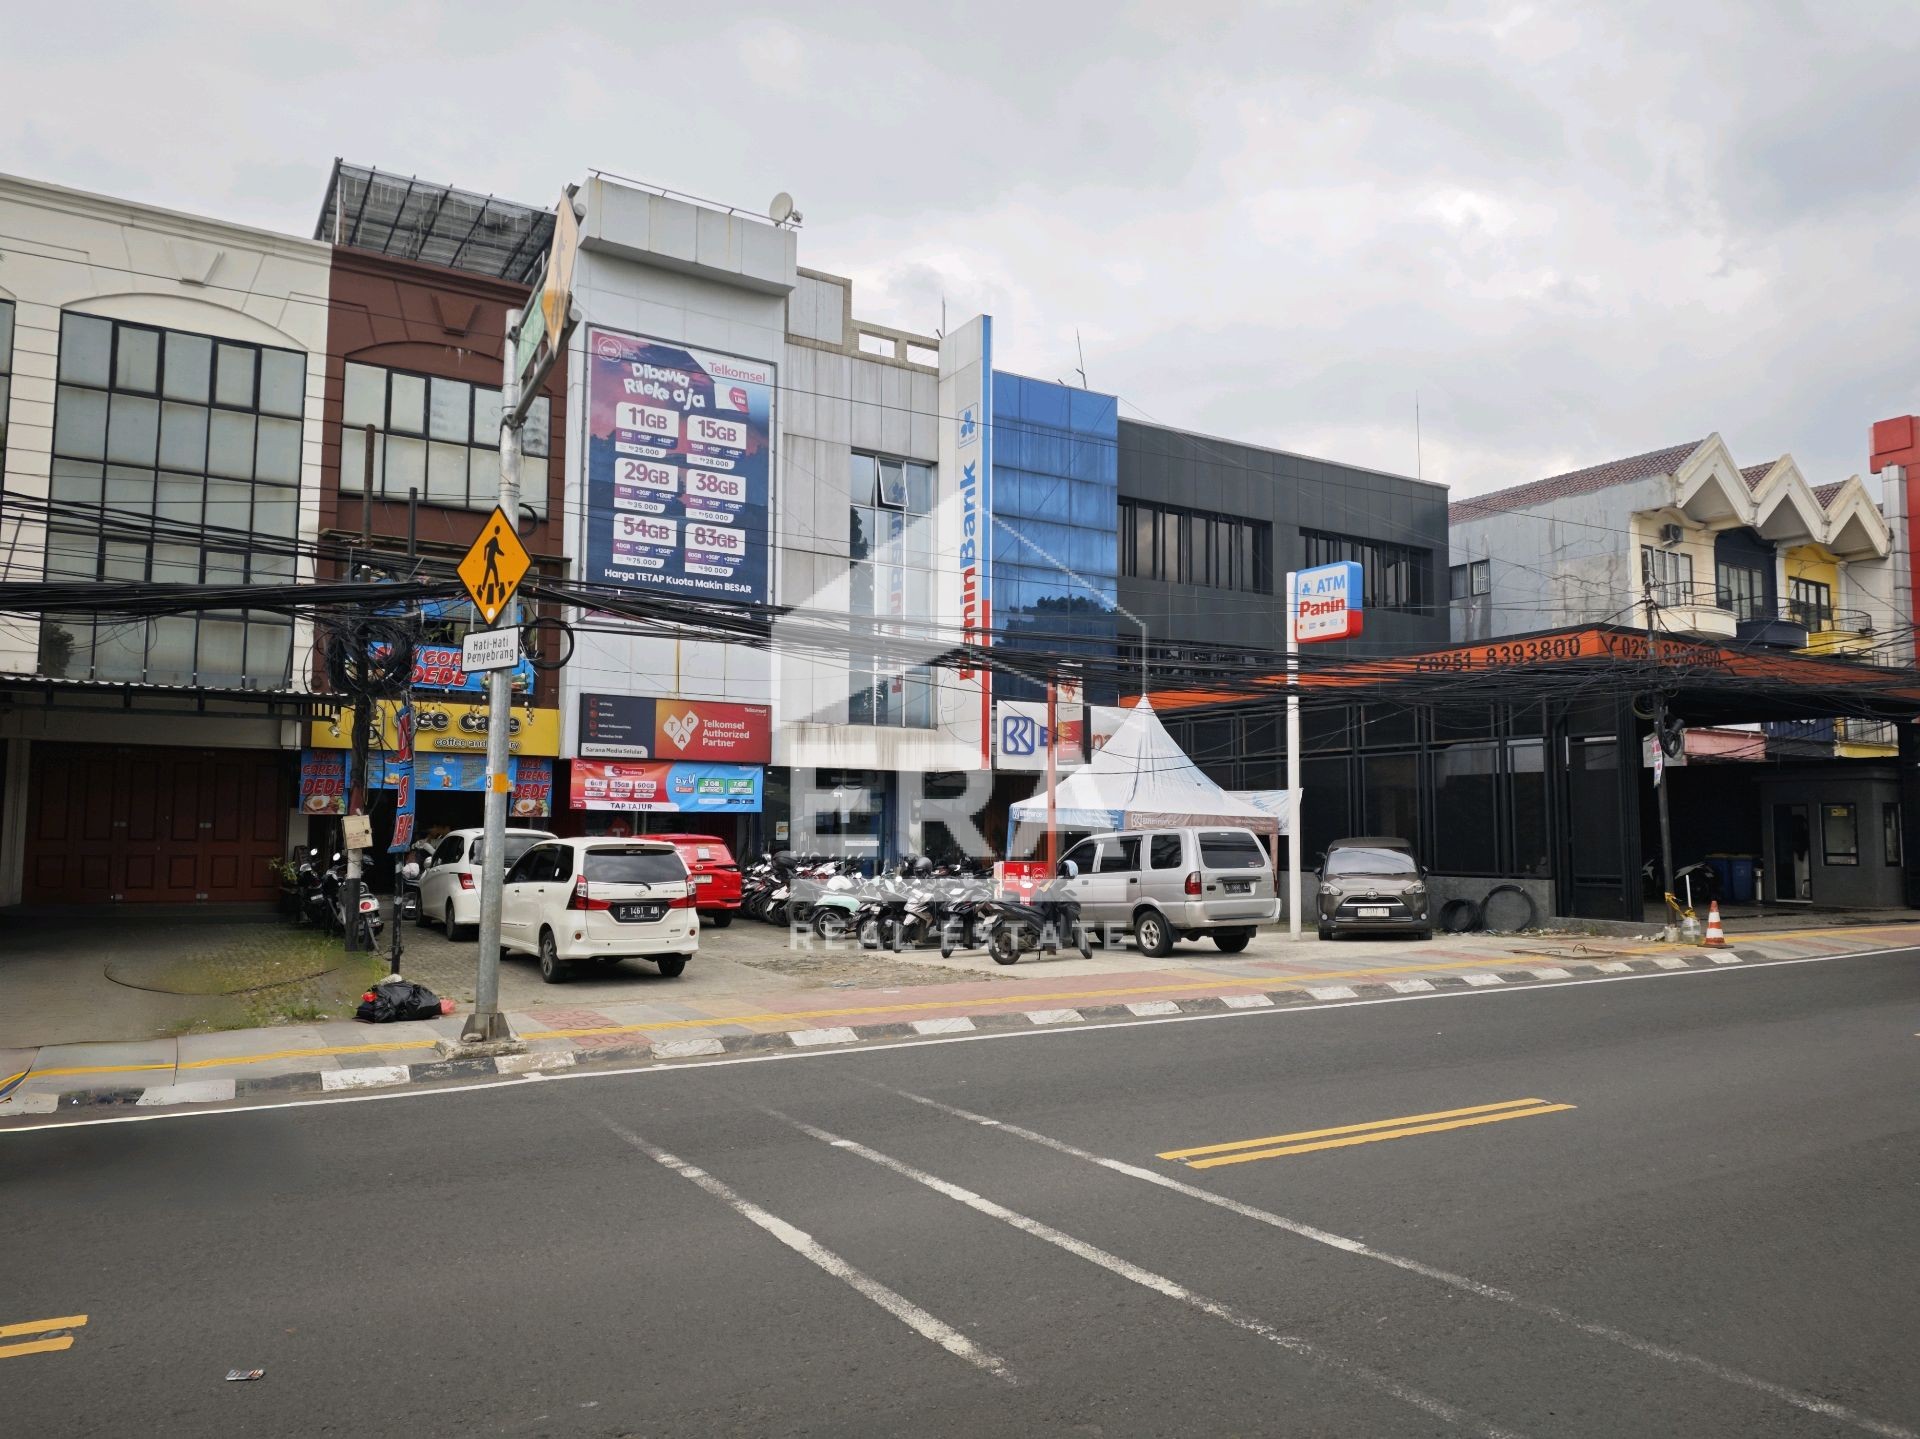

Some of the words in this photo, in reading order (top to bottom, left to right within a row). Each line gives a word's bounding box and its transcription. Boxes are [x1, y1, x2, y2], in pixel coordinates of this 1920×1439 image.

[631, 362, 690, 387] Dibawa
[709, 362, 766, 383] Telkomsel
[623, 378, 670, 401] Rileks
[672, 388, 706, 411] aja
[628, 407, 668, 430] 11GB
[697, 419, 737, 441] 15GB
[624, 461, 670, 485] 29GB
[695, 472, 739, 496] 38GB
[623, 516, 670, 540] 54GB
[694, 526, 738, 549] 83GB
[604, 568, 635, 583] Harga
[636, 572, 665, 583] TETAP
[666, 576, 694, 587] Kuota
[695, 579, 723, 590] Makin
[724, 582, 752, 594] BESAR
[1317, 574, 1346, 594] ATM
[1300, 598, 1346, 618] Panin
[473, 636, 509, 650] Hati-Hati
[1486, 637, 1581, 666] 8393800
[467, 647, 514, 665] Penyebrang
[703, 720, 745, 730] Telkomsel
[703, 729, 750, 739] Authorized
[435, 738, 466, 748] coffee
[469, 740, 488, 749] and
[703, 738, 735, 747] Partner
[517, 771, 550, 781] ORENG
[302, 779, 345, 795] DEDE
